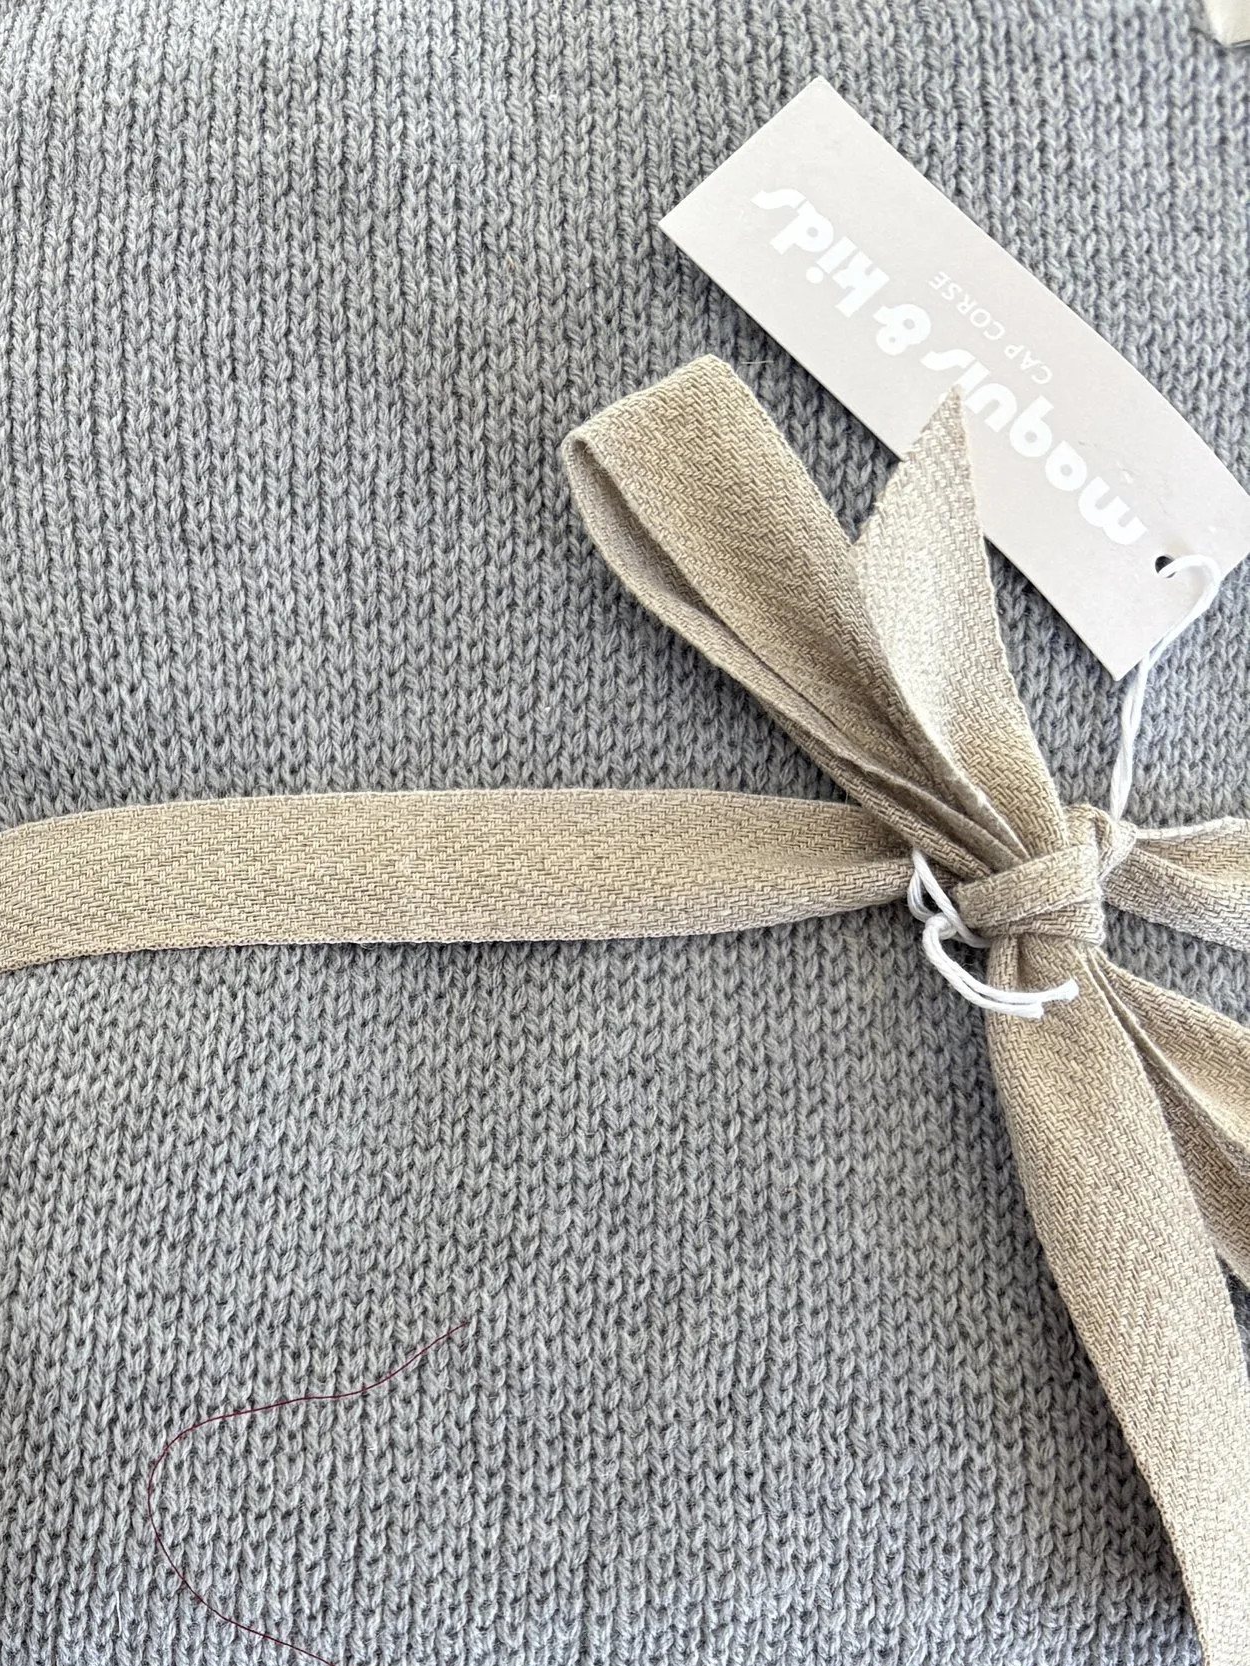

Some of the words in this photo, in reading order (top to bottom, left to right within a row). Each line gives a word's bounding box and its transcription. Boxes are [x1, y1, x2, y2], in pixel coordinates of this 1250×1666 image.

[751, 188, 890, 318] kids
[873, 303, 931, 356] &
[928, 272, 1005, 340] CORSE
[1004, 345, 1052, 384] CAP
[920, 349, 1148, 545] maquis
